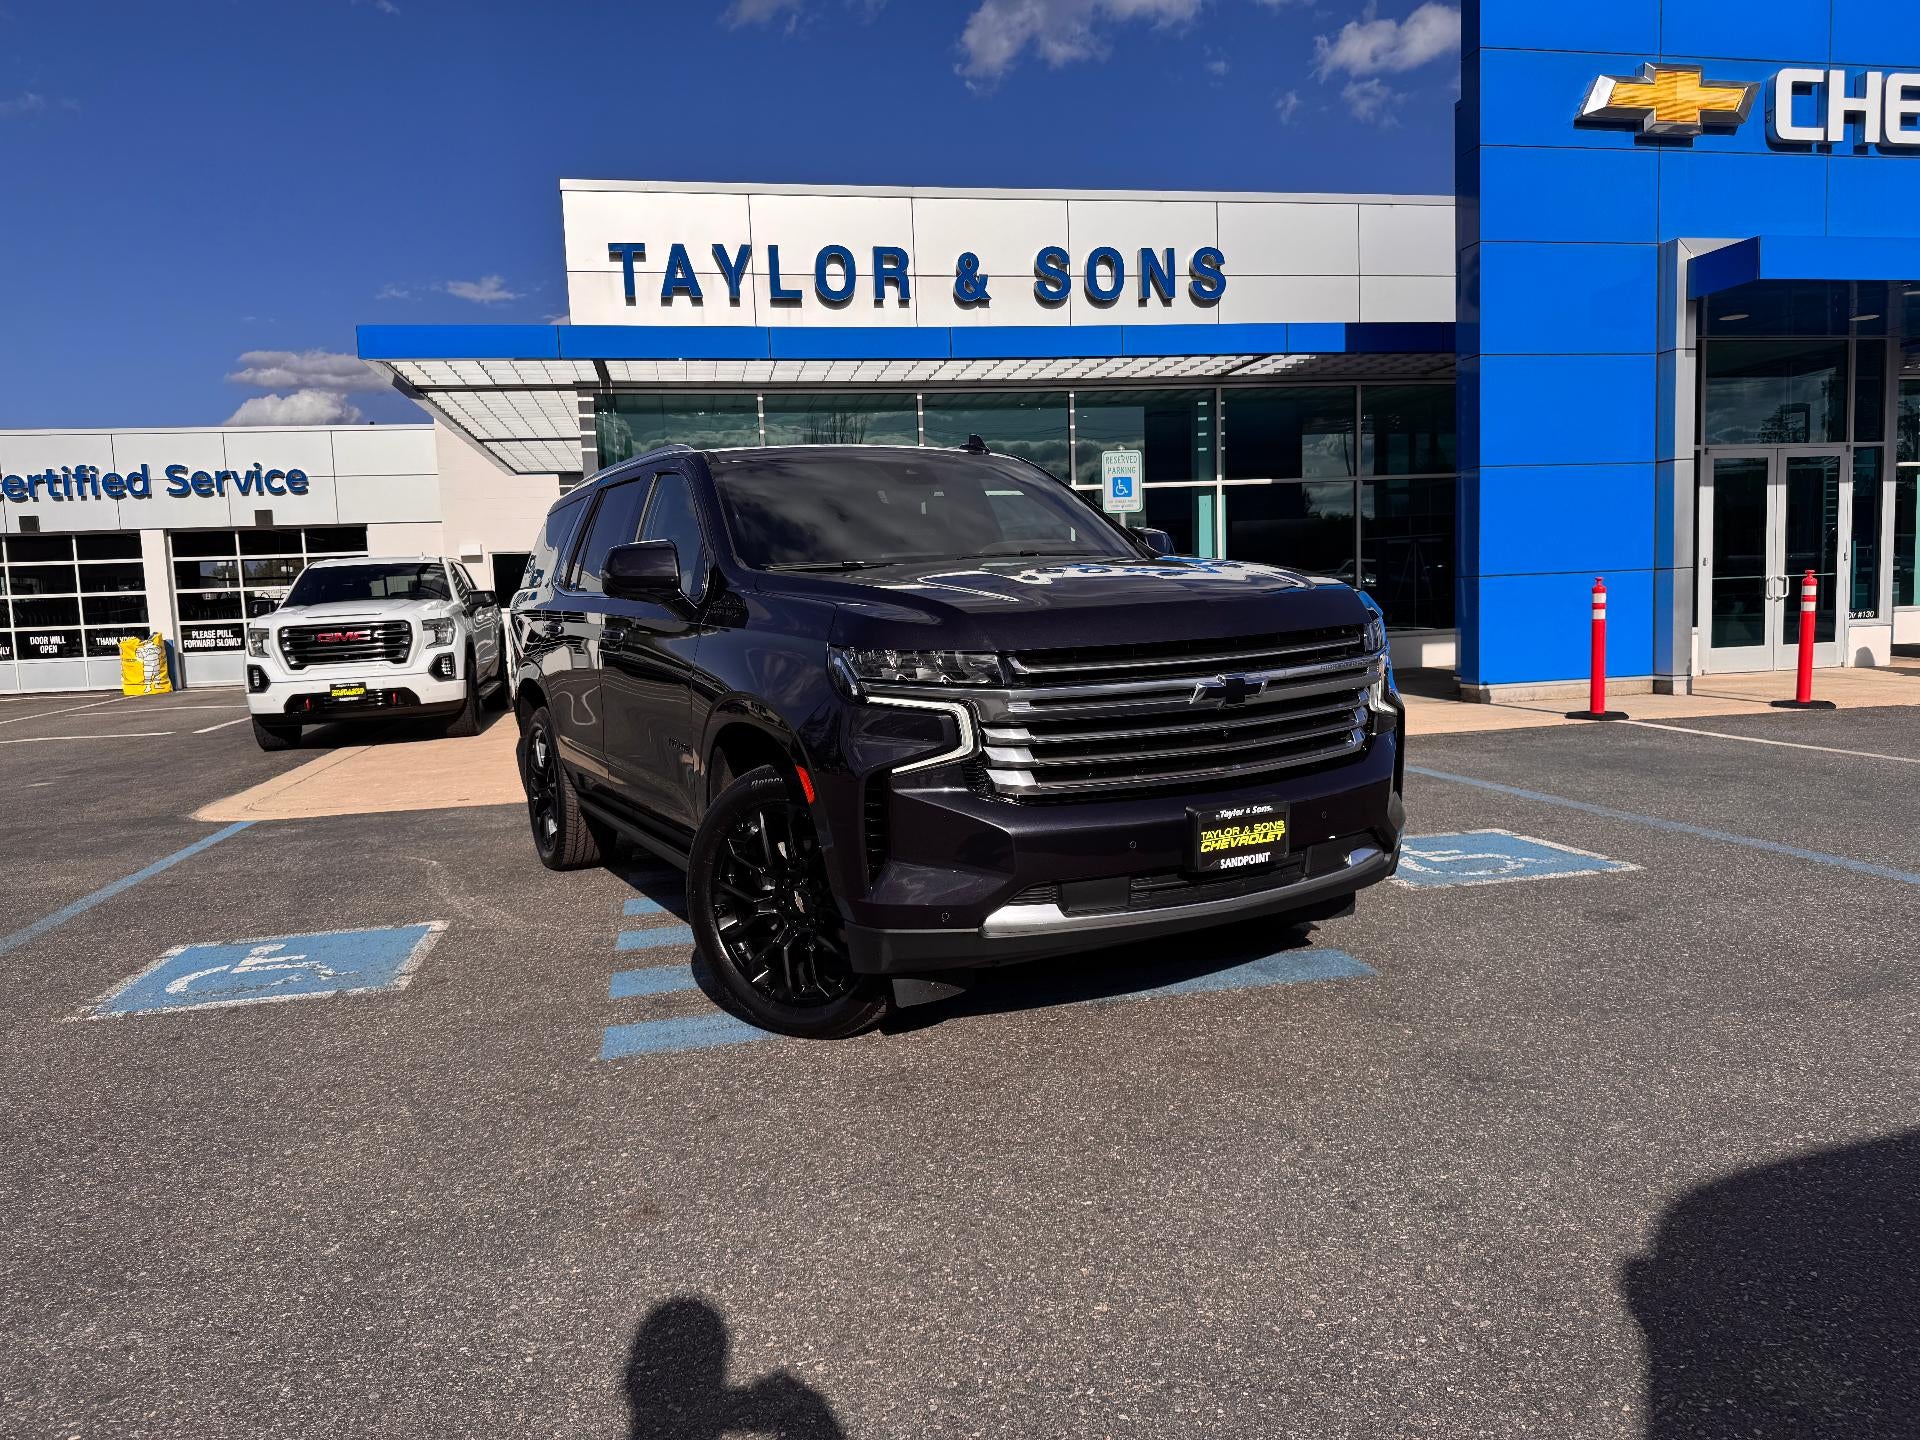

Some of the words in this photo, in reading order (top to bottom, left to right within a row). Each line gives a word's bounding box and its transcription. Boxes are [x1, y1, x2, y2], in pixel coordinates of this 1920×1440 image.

[1772, 68, 1920, 146] CHE
[608, 242, 911, 306] TAYLOR
[953, 251, 991, 303] &
[1032, 245, 1228, 305] SONS
[1105, 455, 1137, 464] RESERVED
[1107, 466, 1136, 475] PARKING
[0, 464, 151, 500] ertified
[165, 462, 310, 497] Service
[1857, 610, 1875, 619] #130
[191, 630, 216, 639] PLEASE
[216, 629, 234, 638] PULL
[317, 630, 371, 642] GMC
[29, 636, 49, 645] DOOR
[49, 635, 66, 645] WILL
[95, 636, 118, 646] THANK
[184, 638, 216, 648] FORWARD
[216, 637, 242, 647] SLOWLY
[40, 644, 58, 654] OPEN
[1219, 808, 1244, 819] Taylor
[1200, 826, 1240, 841] TAYLOR
[1242, 825, 1251, 836] &
[1253, 820, 1285, 832] SONS
[1200, 831, 1284, 853] CHEVROLET
[1220, 852, 1271, 870] SANDPOINT
